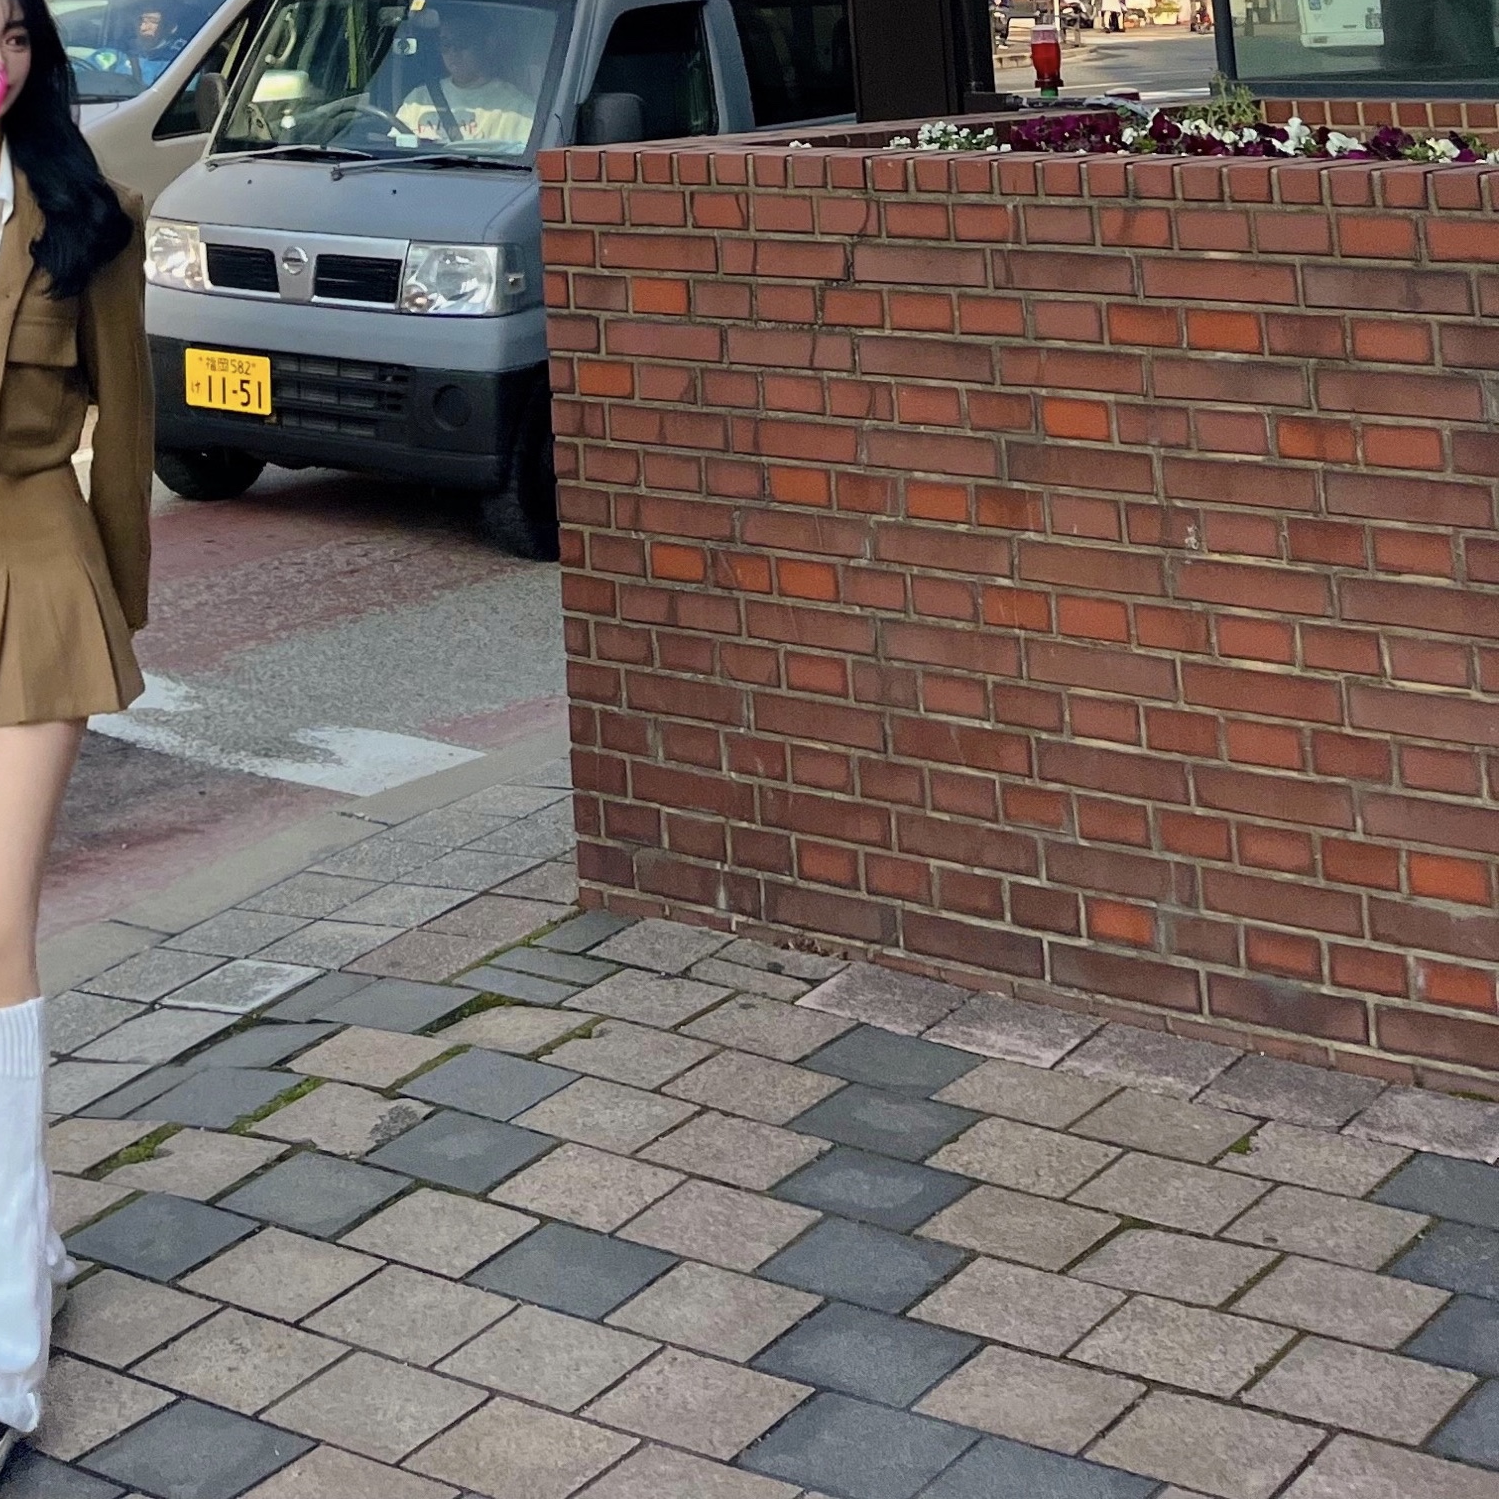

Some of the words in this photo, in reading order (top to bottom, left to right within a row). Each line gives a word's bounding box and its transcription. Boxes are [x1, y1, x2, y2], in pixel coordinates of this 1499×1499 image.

[206, 356, 230, 372] 福岡
[230, 359, 252, 376] 582
[208, 375, 262, 409] 11-51
